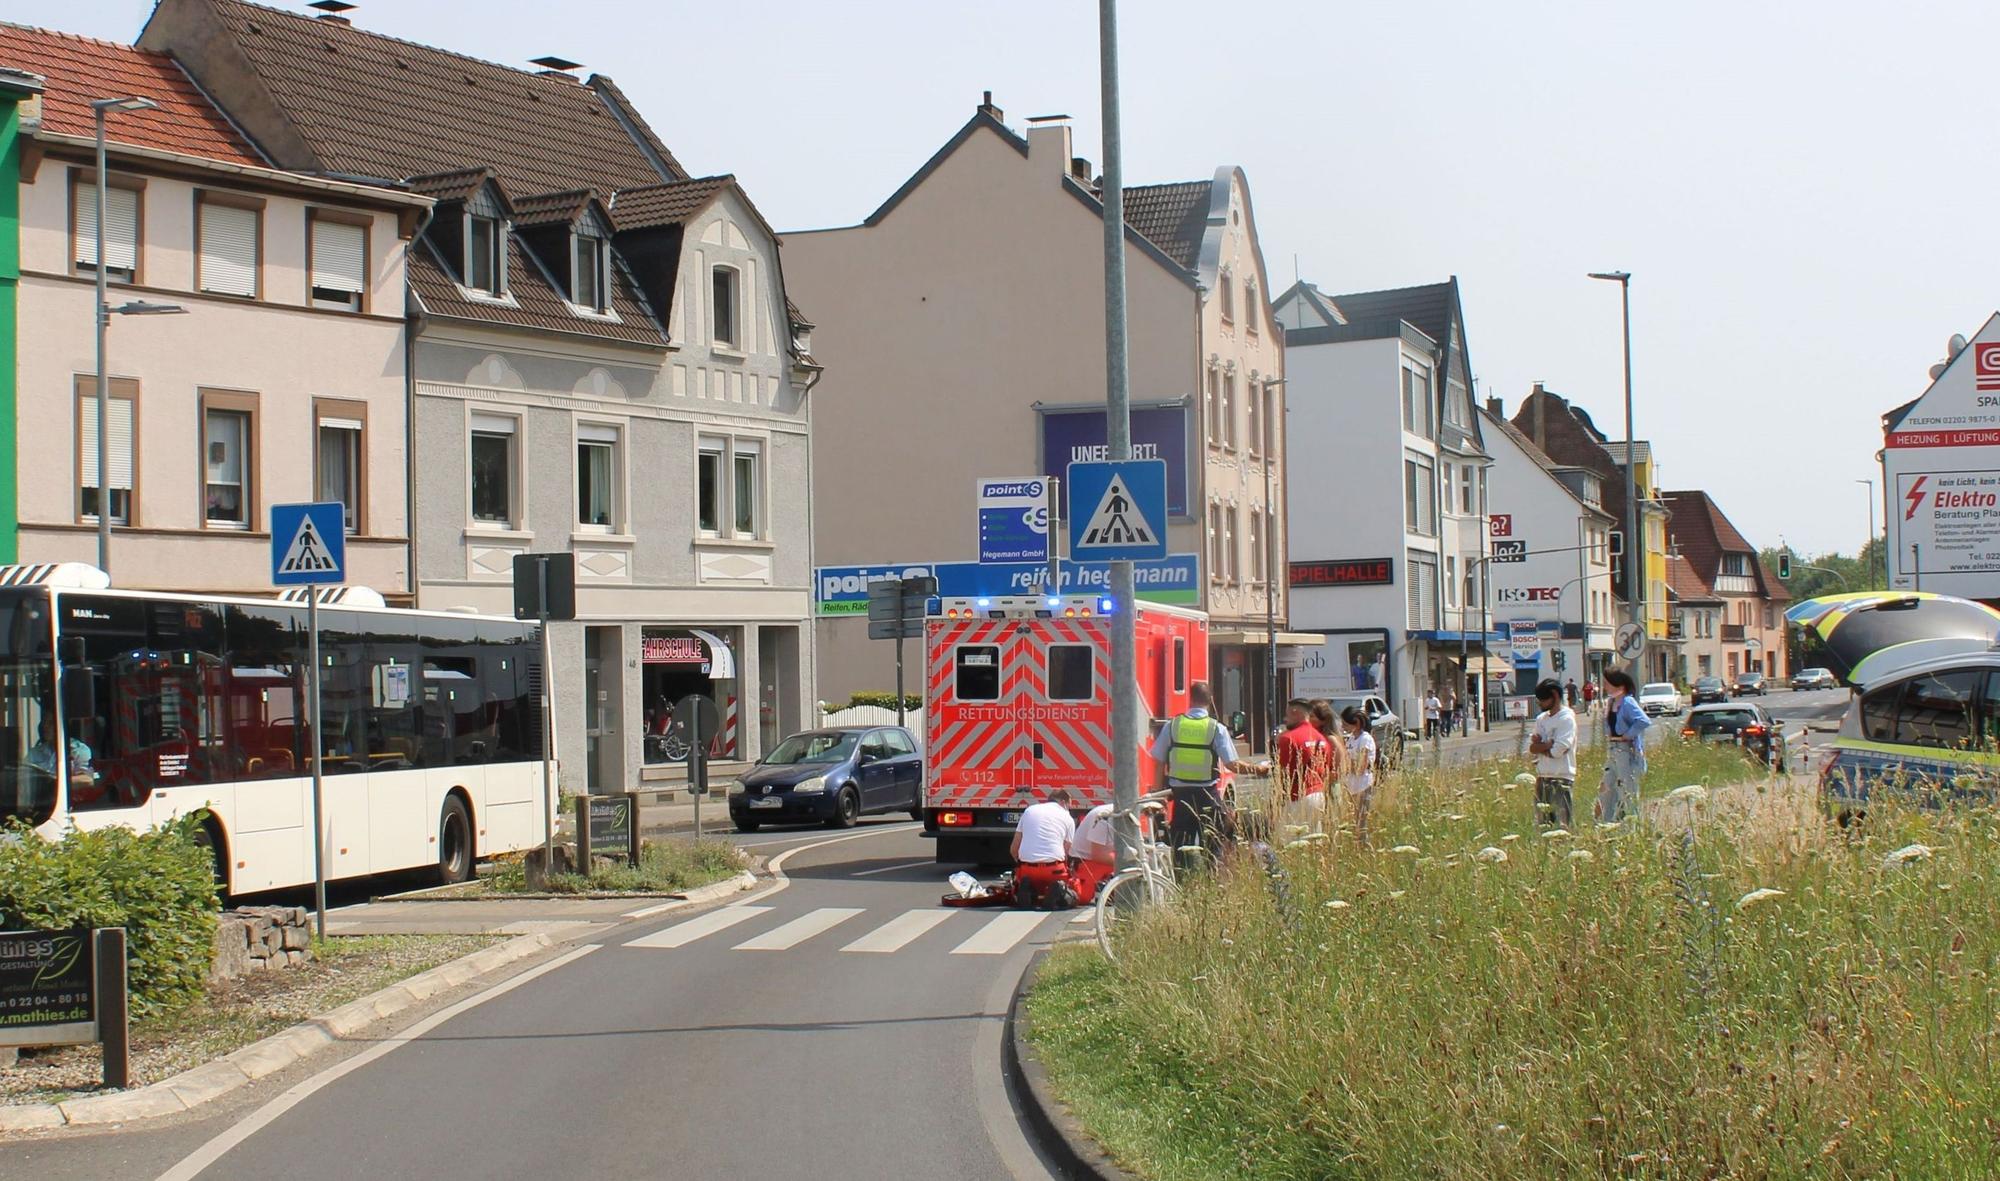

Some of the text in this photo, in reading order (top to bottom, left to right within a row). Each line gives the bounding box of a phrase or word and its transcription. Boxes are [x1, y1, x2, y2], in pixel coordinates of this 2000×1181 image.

[1977, 396, 2000, 407] SPA
[1908, 417, 1941, 425] TELEFON
[1942, 416, 1966, 424] 02202
[1896, 432, 1999, 445] HEIZUNG LÜFTUNG
[1957, 477, 1977, 486] Licht,
[986, 484, 1023, 497] point
[1934, 490, 1996, 508] Elektro
[1934, 510, 1980, 519] Beratung
[982, 549, 1044, 560] Hegemann GmbH
[1968, 552, 1984, 560] Tel.
[1077, 565, 1188, 589] hegmann
[1289, 561, 1388, 582] SPIELHALLE
[1498, 587, 1561, 602] ISOTEC
[72, 608, 93, 618] MAN
[824, 602, 851, 612] Reifen,
[1619, 631, 1641, 651] 30
[1299, 651, 1325, 673] job
[958, 707, 1088, 720] RETTUNGSDIENST
[973, 771, 995, 783] 112
[9, 998, 16, 1008] 0
[18, 996, 32, 1007] 22
[35, 995, 48, 1006] 04
